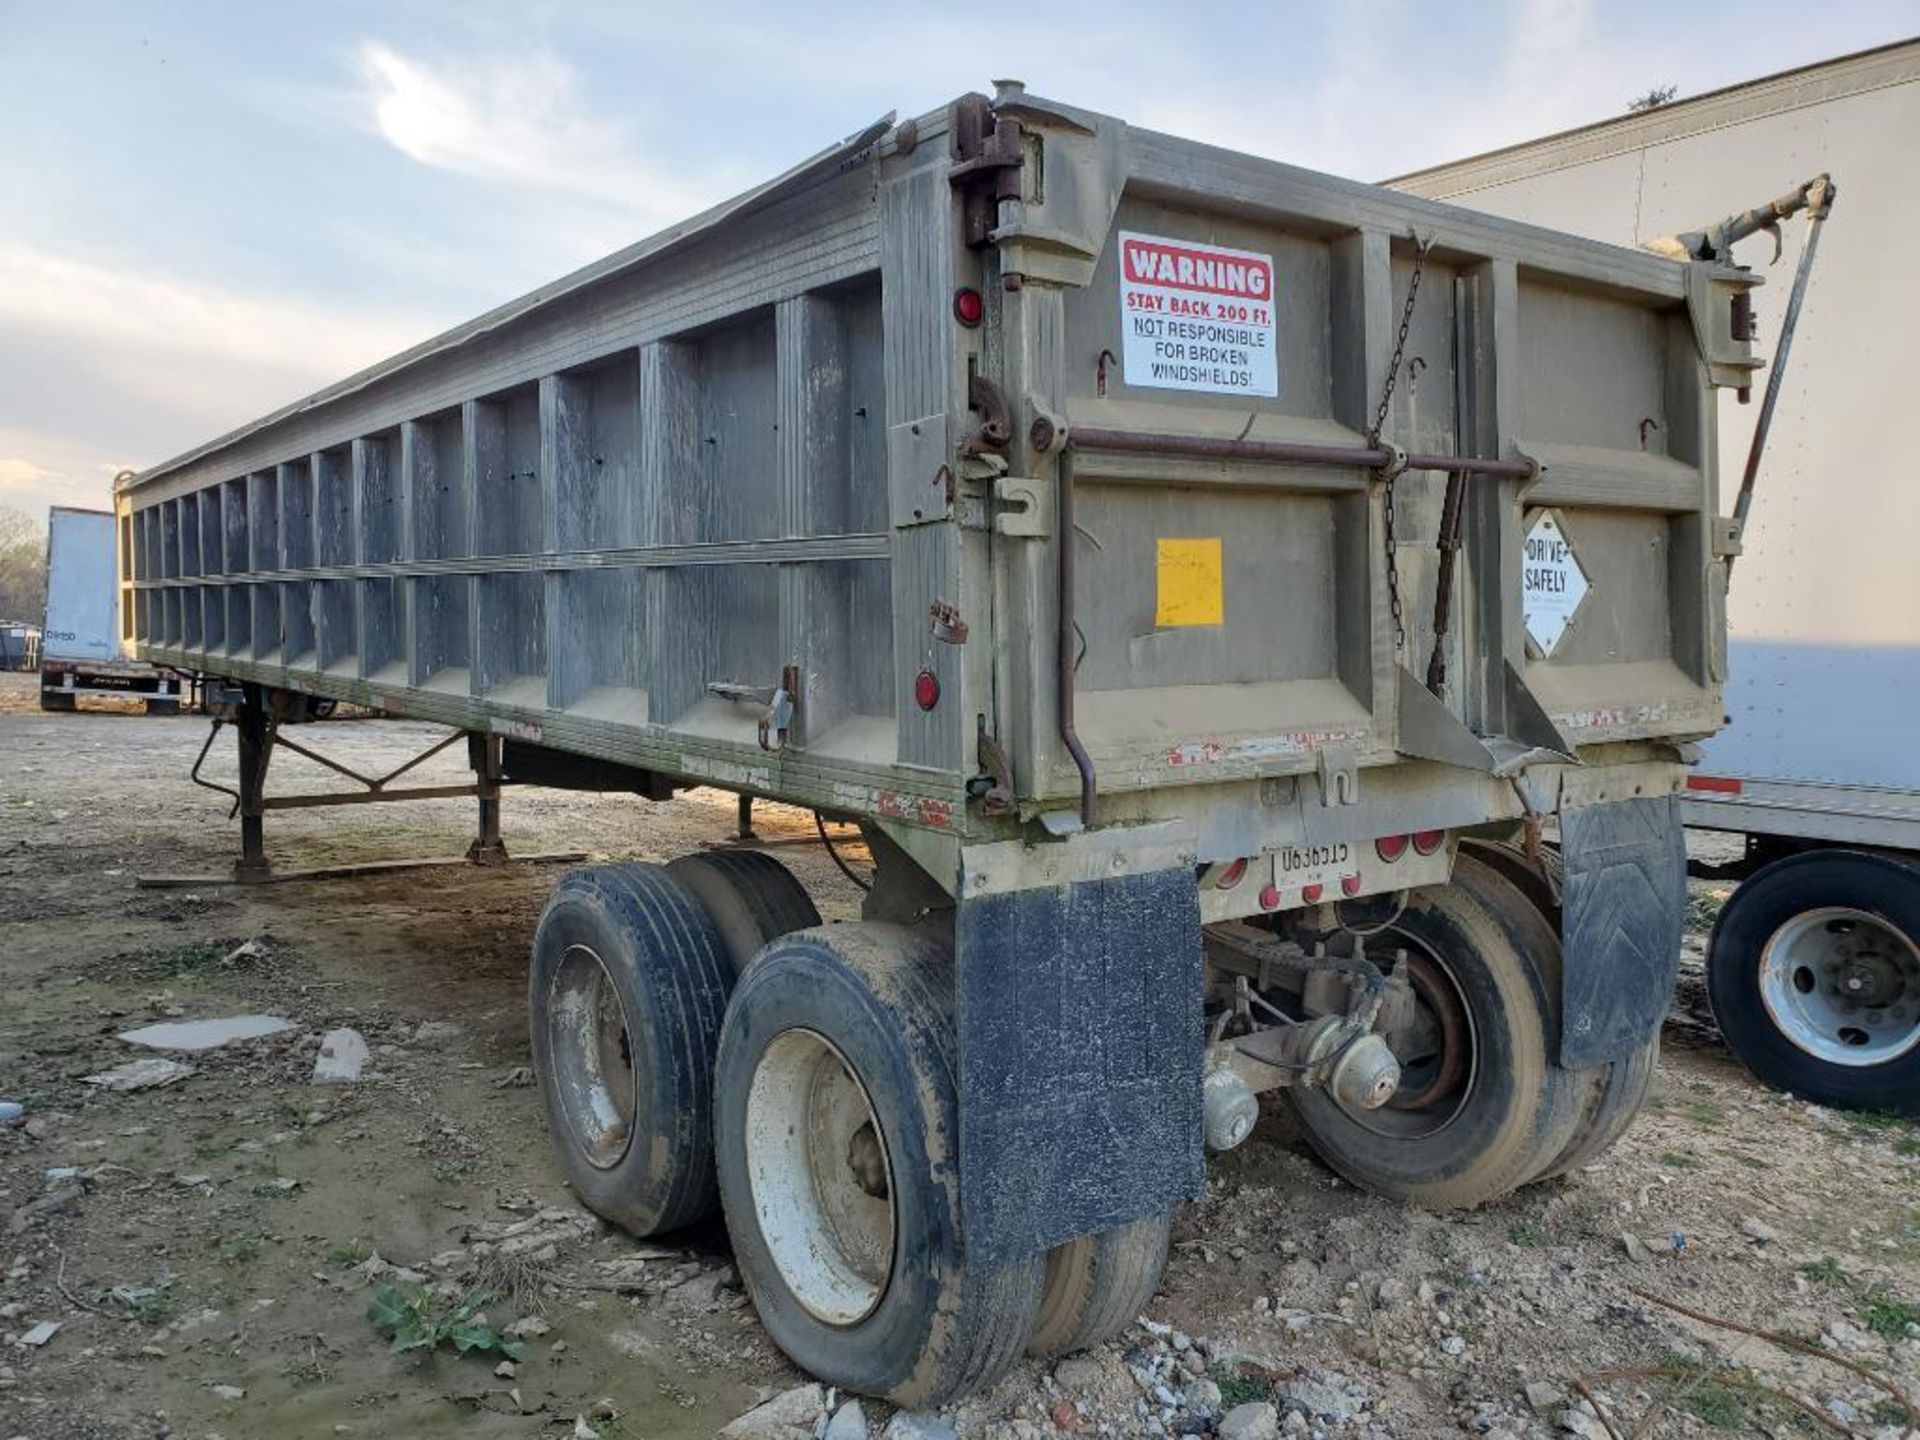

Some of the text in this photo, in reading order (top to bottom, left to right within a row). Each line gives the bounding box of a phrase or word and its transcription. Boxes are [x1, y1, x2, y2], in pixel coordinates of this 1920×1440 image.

[1129, 248, 1265, 294] WARNING
[1127, 291, 1271, 325] STAY BACK 200 FT.
[1134, 318, 1265, 347] NOT RESPONSIBLE
[1155, 342, 1248, 365] FOR BROKEN
[1151, 362, 1252, 387] WINDSHIELDS!
[1527, 538, 1563, 563] DRIVE
[1525, 569, 1567, 592] SAFELY
